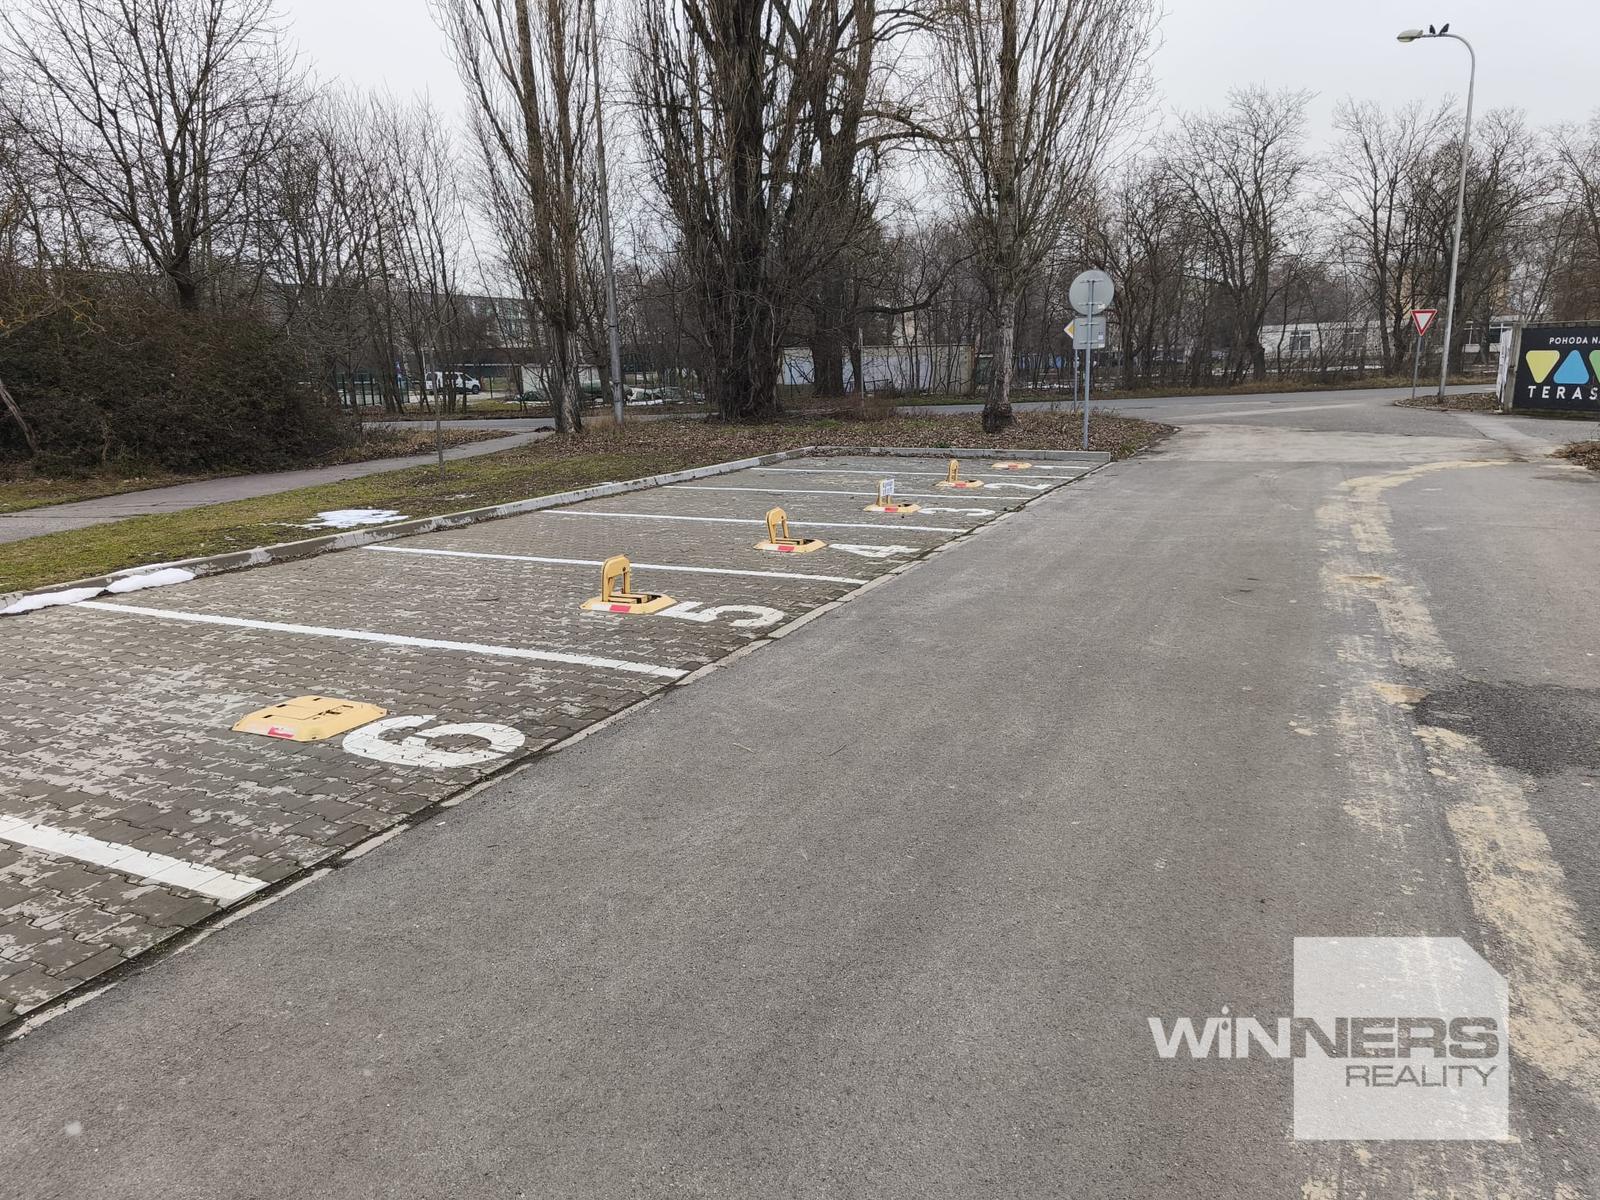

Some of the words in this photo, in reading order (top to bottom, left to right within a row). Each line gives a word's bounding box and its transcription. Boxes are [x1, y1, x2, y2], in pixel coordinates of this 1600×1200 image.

[1549, 336, 1588, 344] POHODA
[1528, 386, 1598, 400] TERAS
[654, 601, 786, 627] 5
[342, 714, 526, 769] 6
